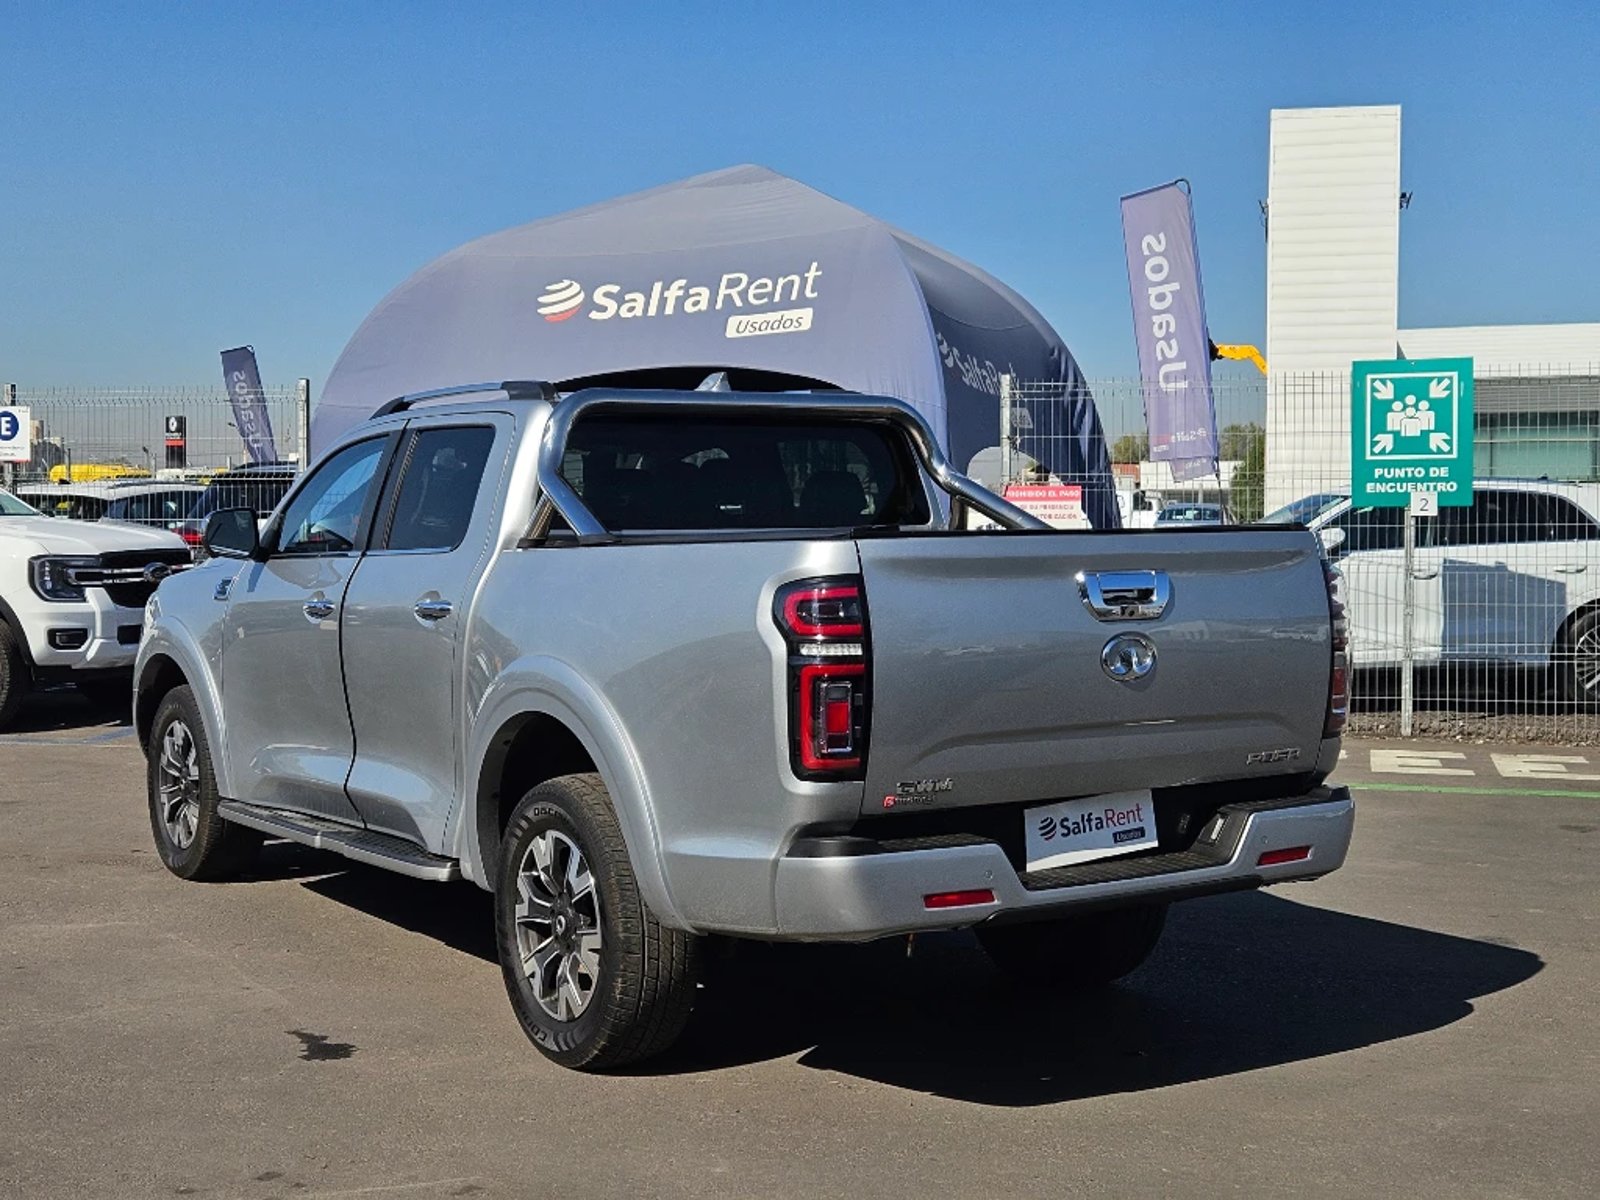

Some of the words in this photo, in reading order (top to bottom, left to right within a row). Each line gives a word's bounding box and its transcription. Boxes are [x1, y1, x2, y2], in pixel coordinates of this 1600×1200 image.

[588, 261, 823, 320] SalfaRent
[735, 314, 803, 335] Usados
[1374, 467, 1425, 479] PUNTO
[1429, 466, 1449, 478] DE
[1366, 481, 1457, 493] ENCUENTRO
[1419, 497, 1429, 512] 2
[1059, 803, 1144, 838] SalfaRent
